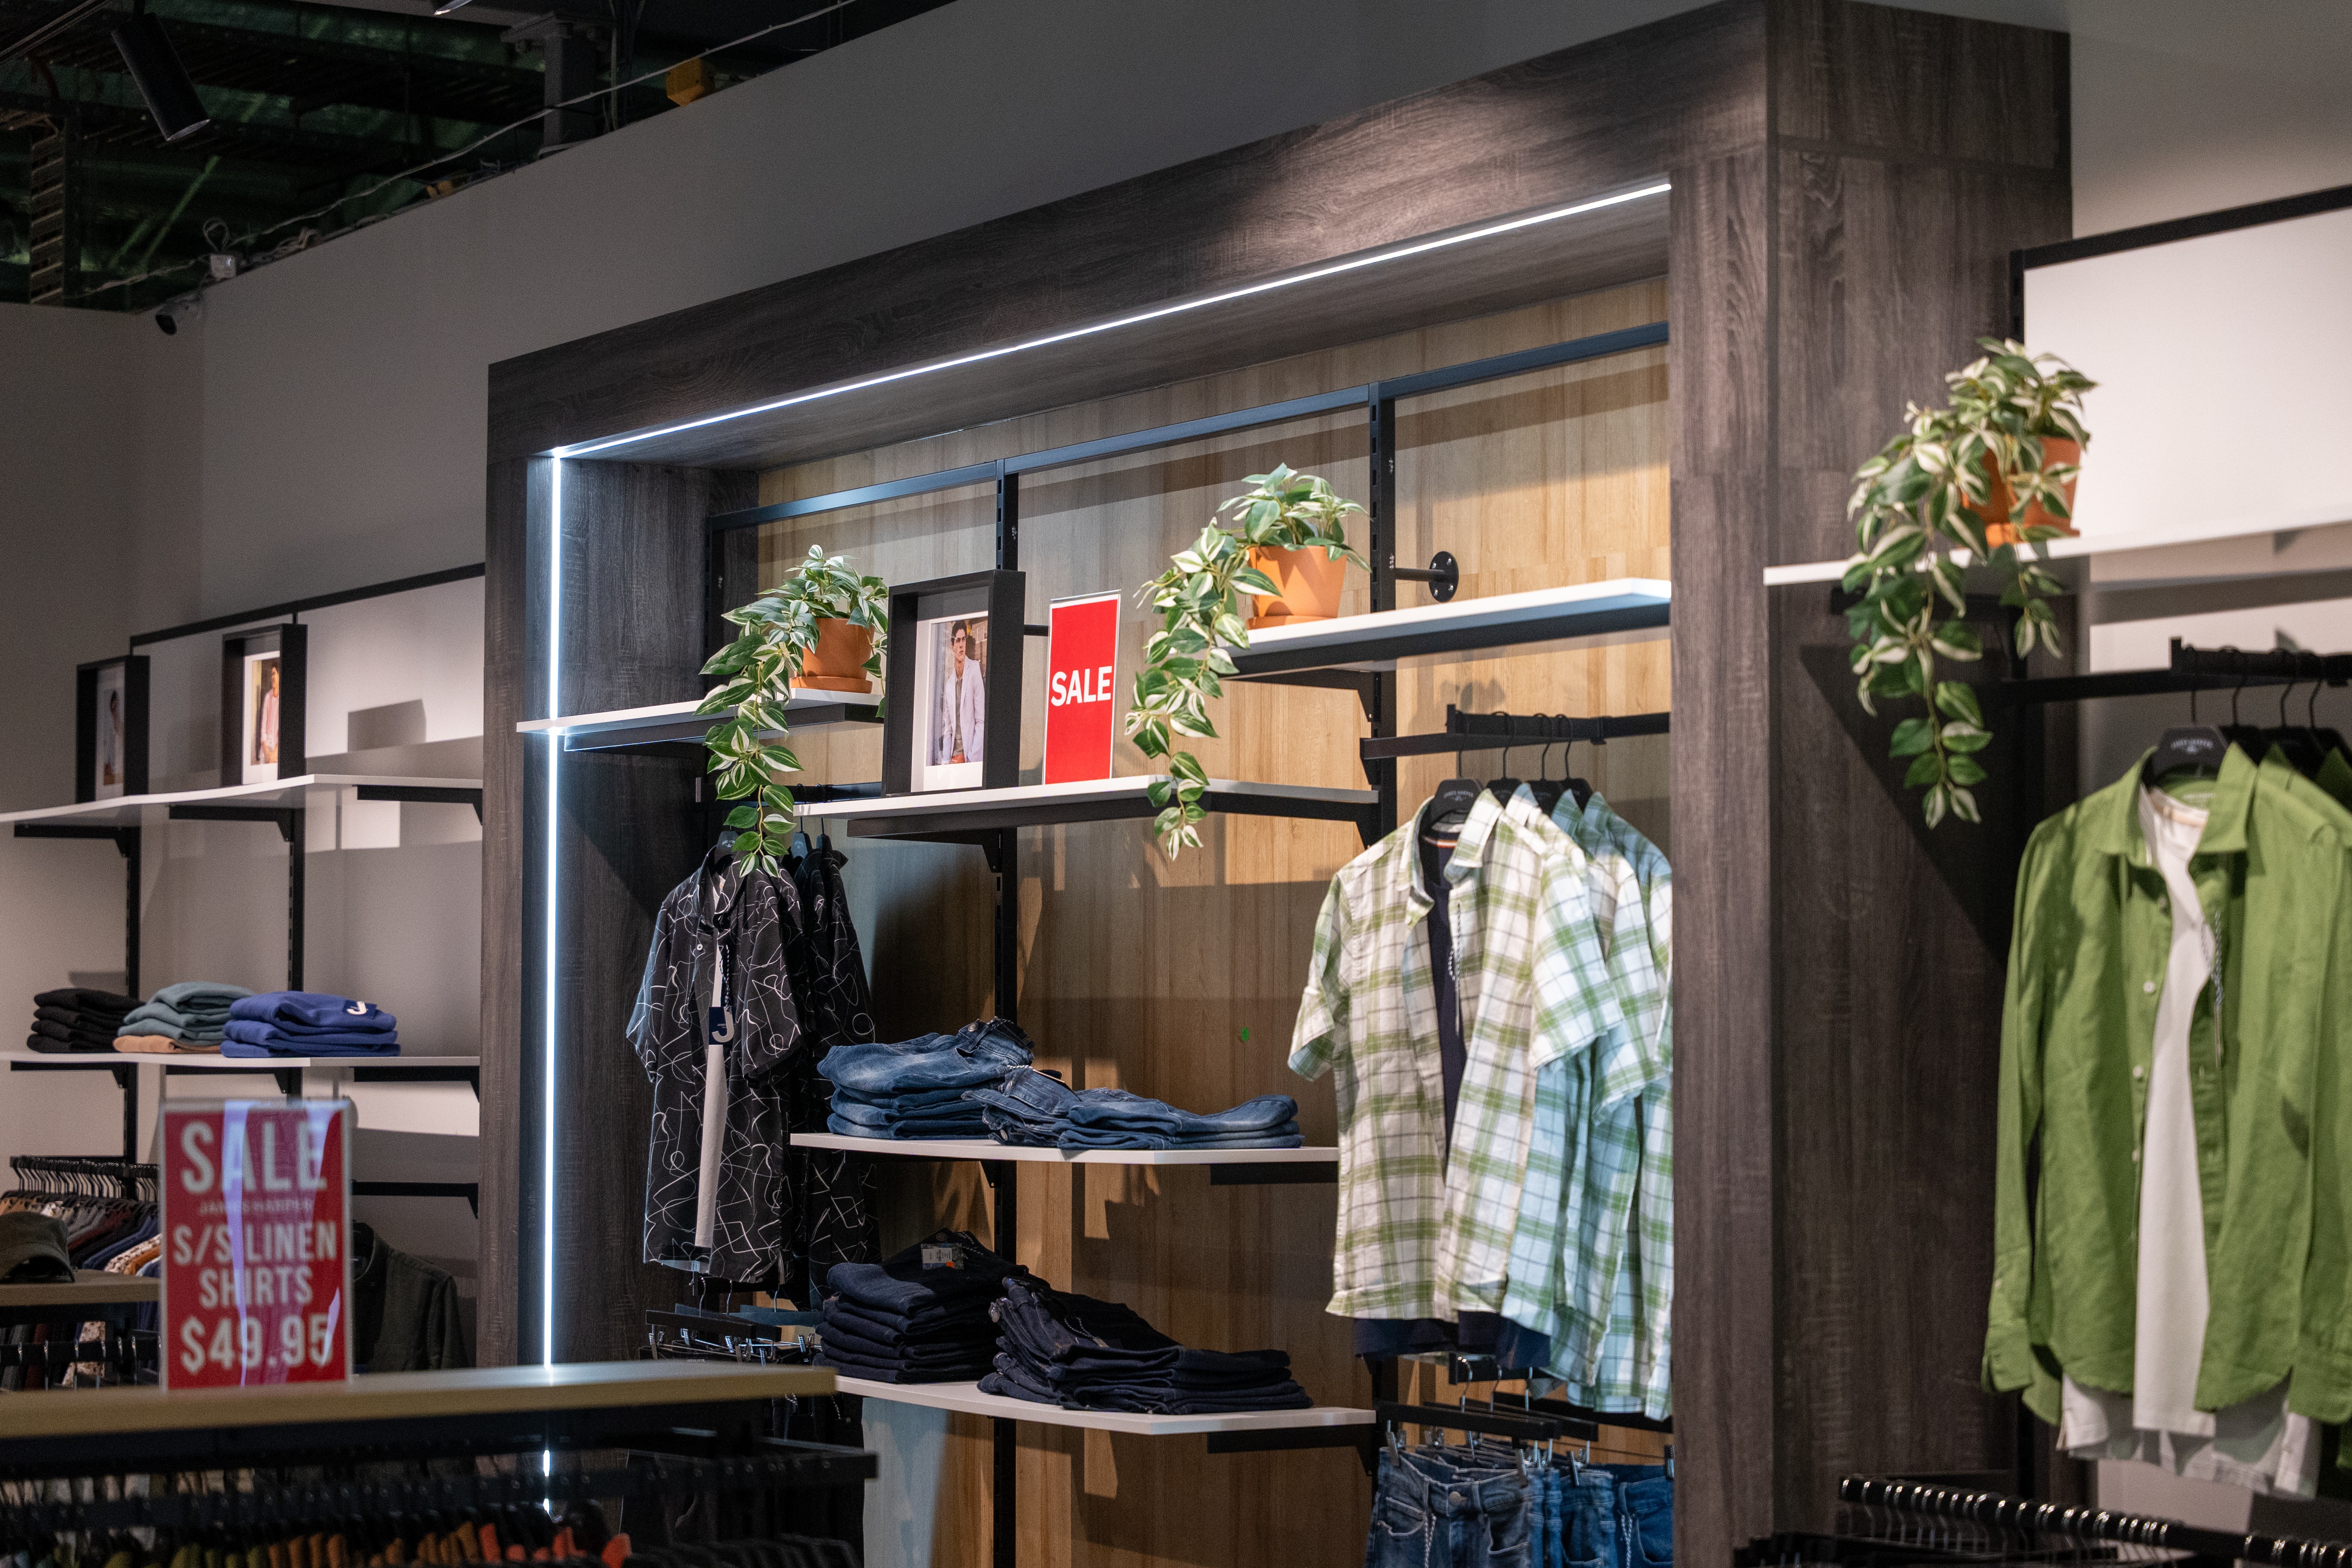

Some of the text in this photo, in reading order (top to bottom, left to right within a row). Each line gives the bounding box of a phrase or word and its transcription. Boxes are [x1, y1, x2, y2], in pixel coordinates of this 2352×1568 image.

[1051, 666, 1112, 707] SALE
[180, 1121, 327, 1194] SALE
[173, 1221, 337, 1266] S/S LINEN
[200, 1266, 313, 1310] SHIRTS
[180, 1315, 333, 1375] $49.95
